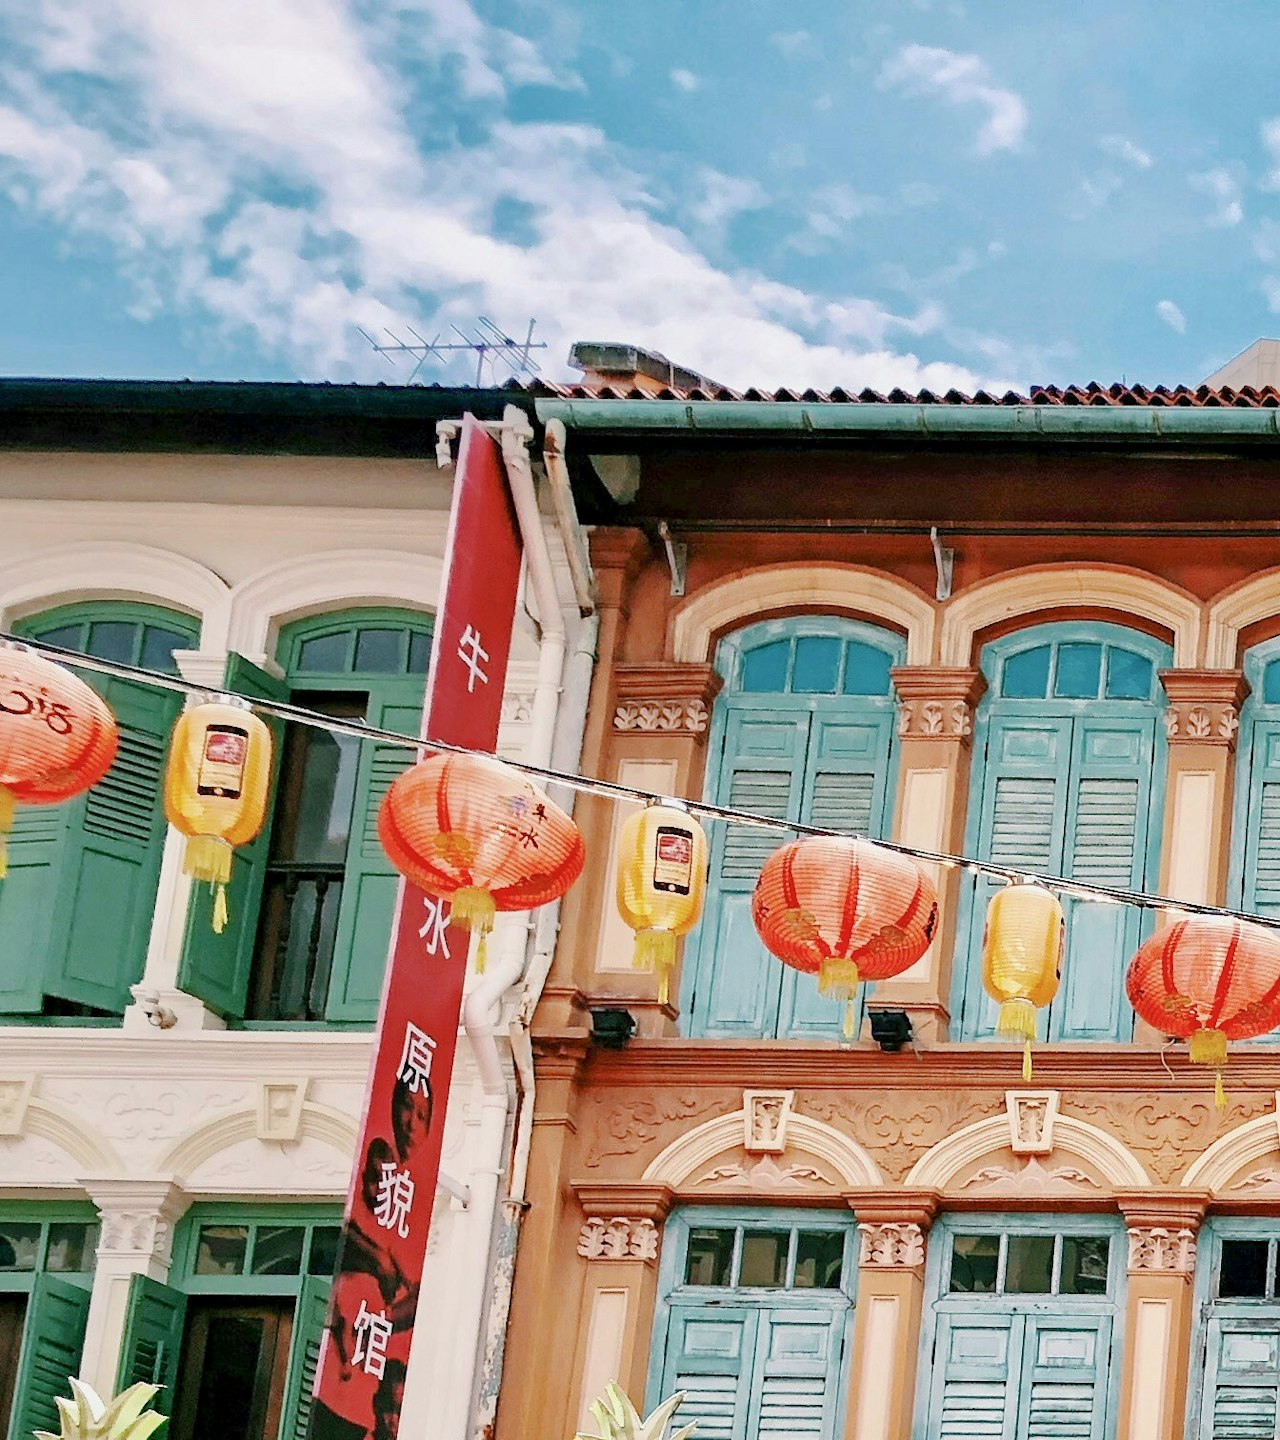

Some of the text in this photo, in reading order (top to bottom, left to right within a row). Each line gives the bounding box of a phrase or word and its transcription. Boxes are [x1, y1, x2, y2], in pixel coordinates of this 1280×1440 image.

[350, 622, 491, 1382] 牛水原貌馆
